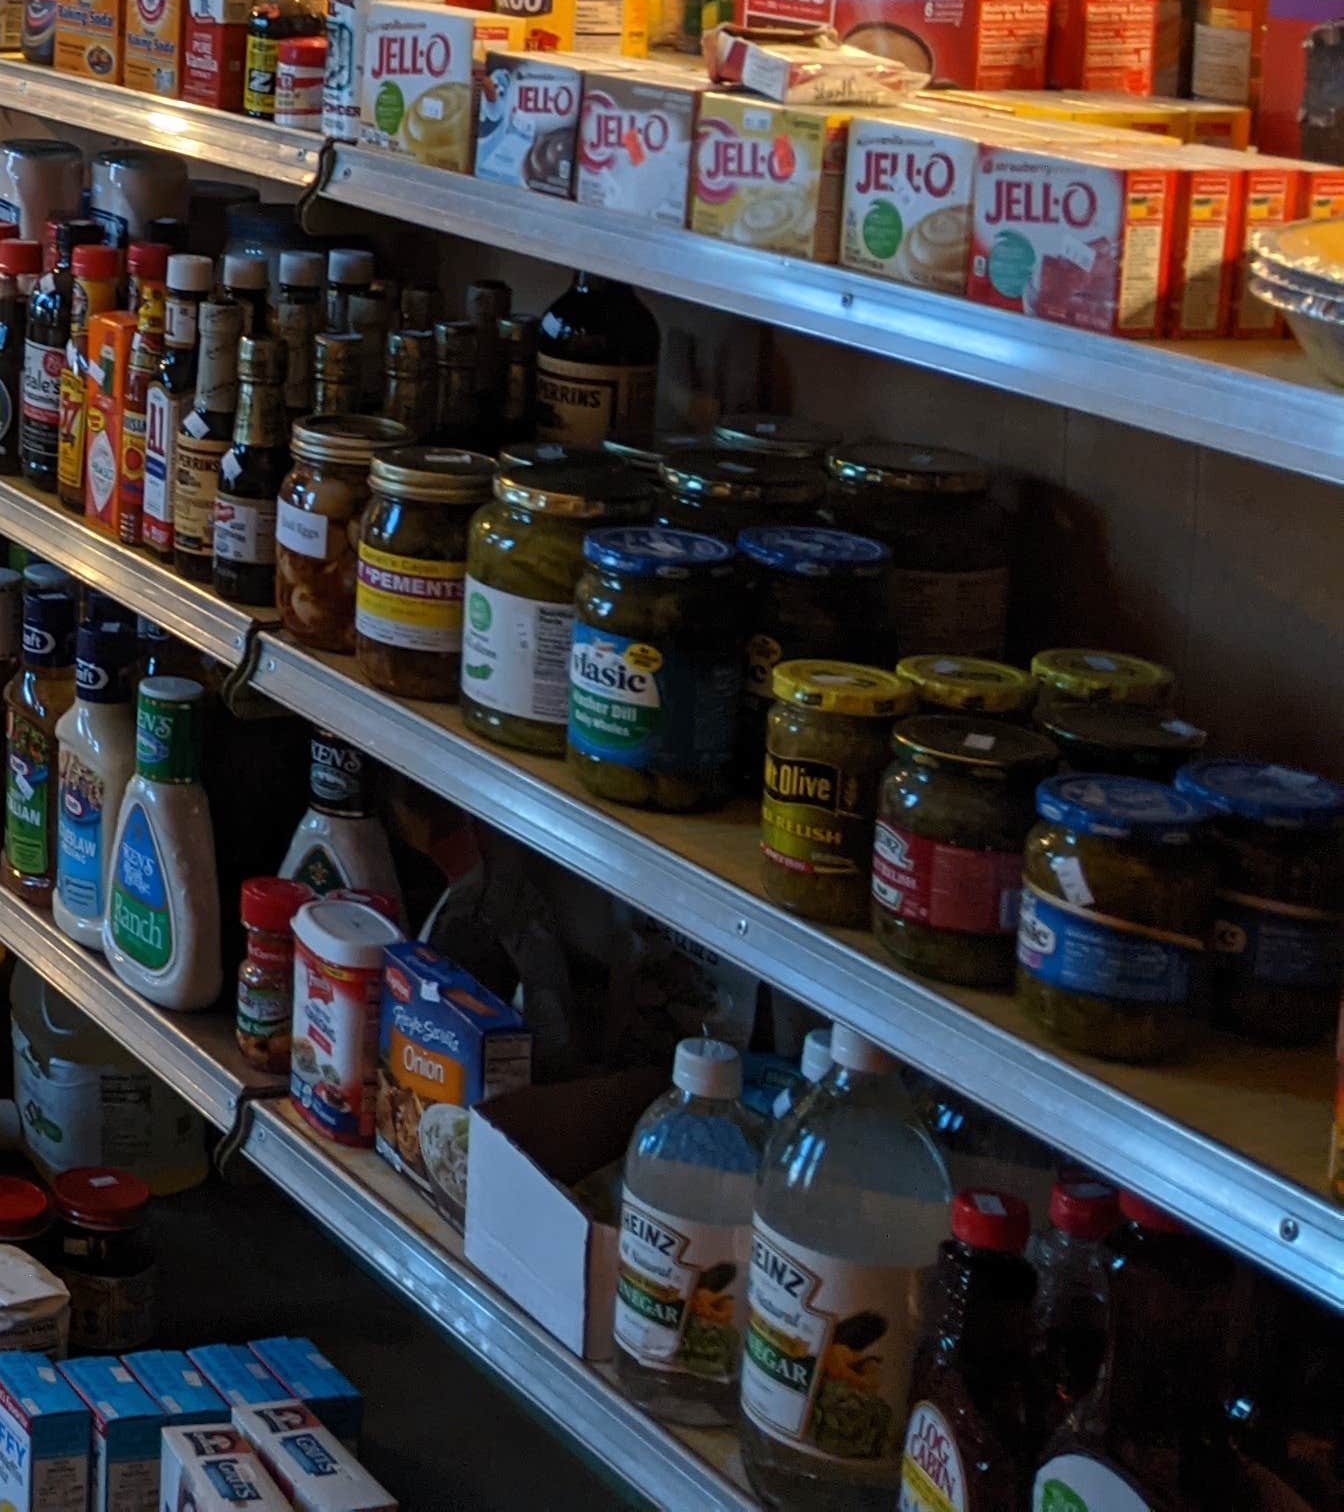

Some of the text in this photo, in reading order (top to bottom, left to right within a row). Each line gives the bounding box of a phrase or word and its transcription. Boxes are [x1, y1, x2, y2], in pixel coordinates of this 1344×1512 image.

[779, 764, 831, 801] Olive
[776, 815, 842, 846] RELISH
[115, 891, 163, 951] Ranch
[402, 1045, 445, 1084] Onion
[752, 1242, 805, 1299] EINZ
[916, 1412, 952, 1457] LOG
